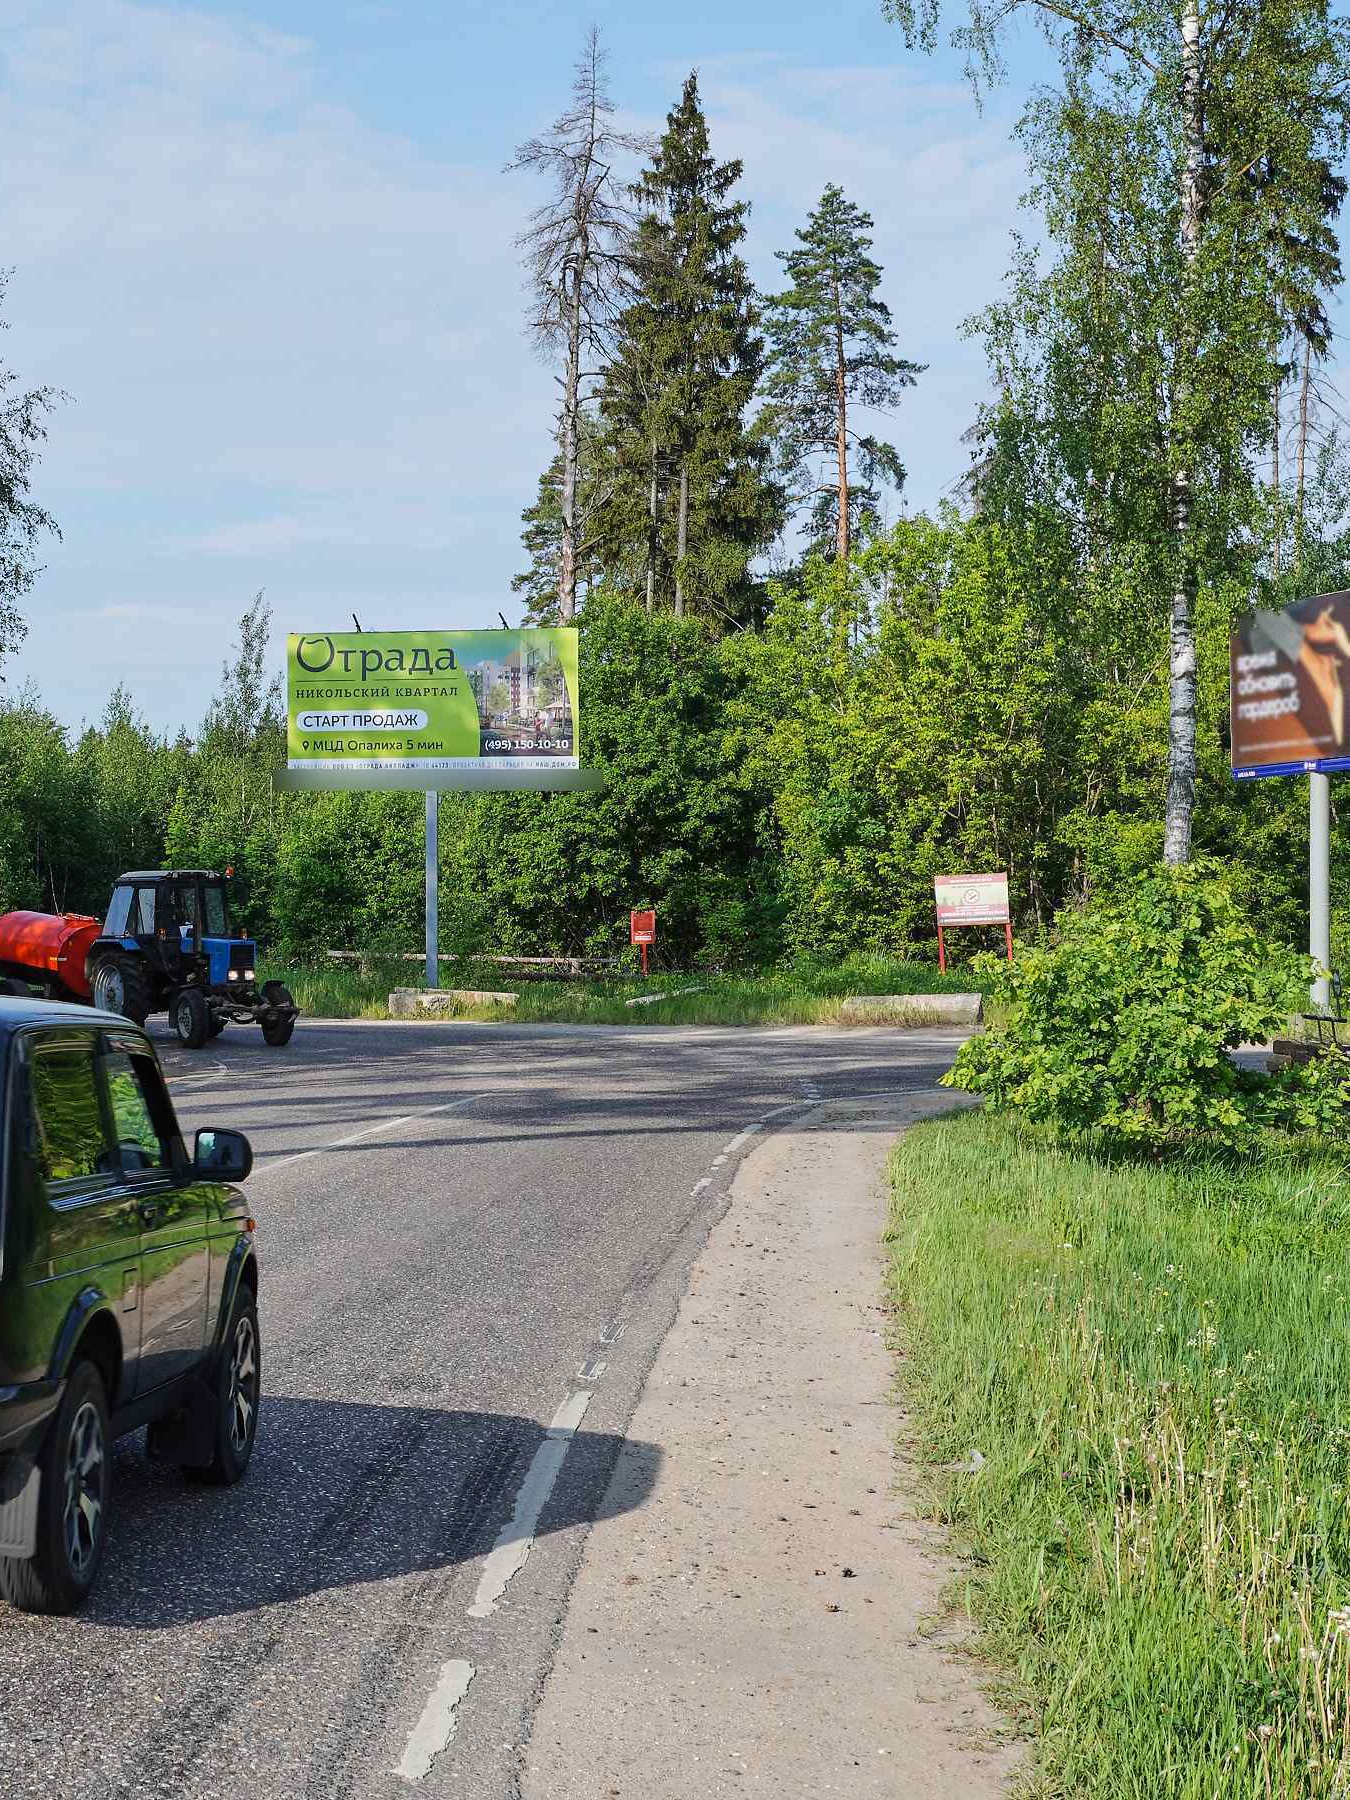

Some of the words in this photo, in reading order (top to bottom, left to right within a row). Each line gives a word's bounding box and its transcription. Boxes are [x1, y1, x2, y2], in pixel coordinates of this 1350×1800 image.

[296, 636, 458, 682] Отрада
[296, 685, 391, 699] НИКОЛЬСКИЙ
[395, 687, 458, 697] КВАРТАЛ
[303, 715, 349, 728] СТАРТ
[352, 714, 418, 728] ПРОДАЖ
[313, 740, 345, 753] МЦД
[347, 739, 403, 751] Опалиха
[406, 739, 415, 751] 5
[417, 741, 443, 750] мин
[484, 739, 512, 751] (495)
[514, 739, 569, 749] 150-10-10
